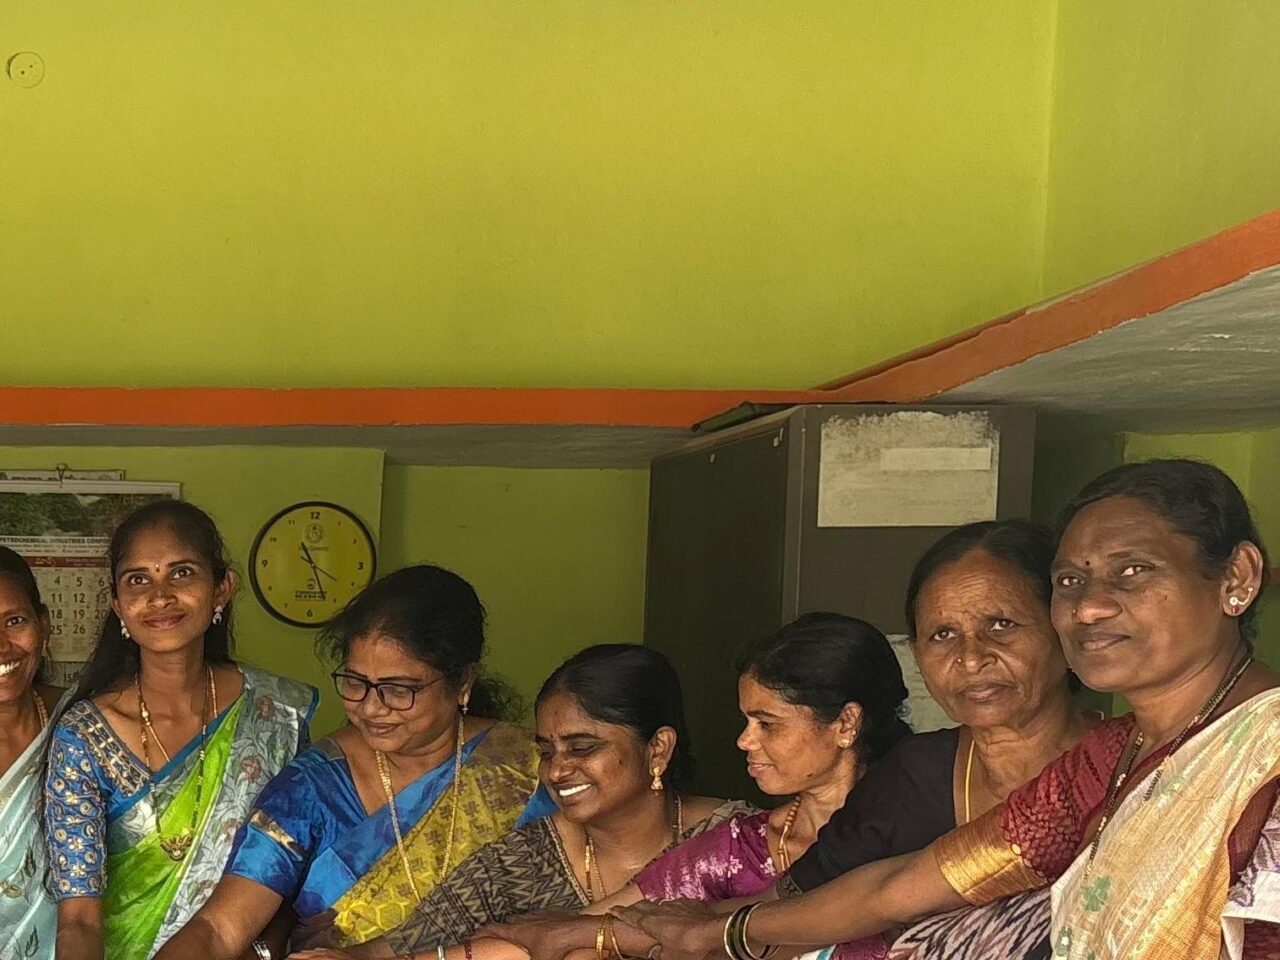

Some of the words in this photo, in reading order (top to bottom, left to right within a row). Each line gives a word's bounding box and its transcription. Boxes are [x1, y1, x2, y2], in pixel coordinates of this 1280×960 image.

[310, 512, 320, 520] 12
[261, 560, 268, 568] 9
[357, 562, 364, 570] 3
[54, 576, 61, 585] 4
[76, 577, 83, 587] 5
[98, 577, 105, 587] 6
[51, 593, 63, 603] 11
[73, 593, 86, 603] 12
[96, 593, 107, 603] 13
[51, 609, 63, 619] 18
[73, 609, 85, 619] 19
[306, 609, 313, 617] 6
[50, 625, 62, 635] 25
[72, 624, 86, 635] 26
